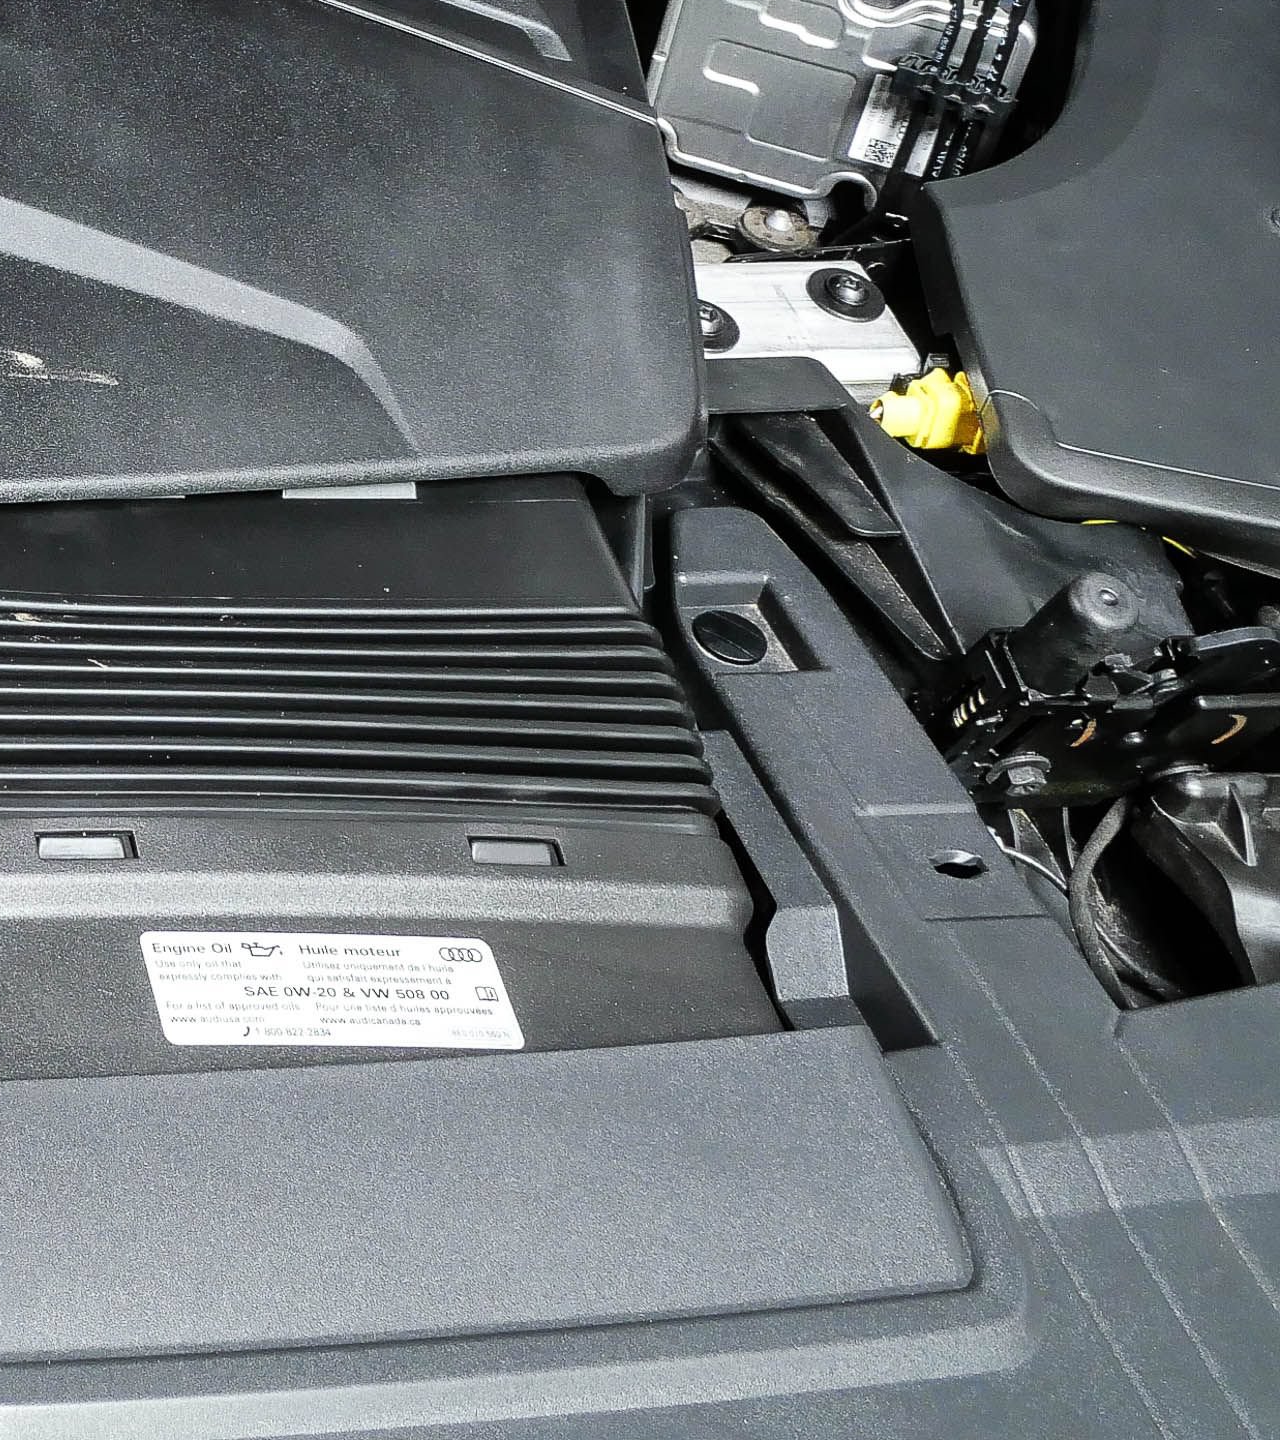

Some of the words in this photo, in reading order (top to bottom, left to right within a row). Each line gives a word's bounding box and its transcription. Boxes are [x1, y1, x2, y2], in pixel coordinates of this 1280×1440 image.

[152, 943, 206, 955] Engine
[211, 943, 232, 954] Oil
[299, 945, 338, 955] Huile
[344, 946, 401, 957] moteur
[221, 960, 242, 968] that
[261, 972, 282, 981] with
[244, 986, 279, 997] SAE
[283, 986, 336, 998] 0W-20
[344, 987, 355, 998] &
[360, 988, 389, 999] VW
[396, 989, 425, 1000] 508
[430, 990, 450, 1000] 00
